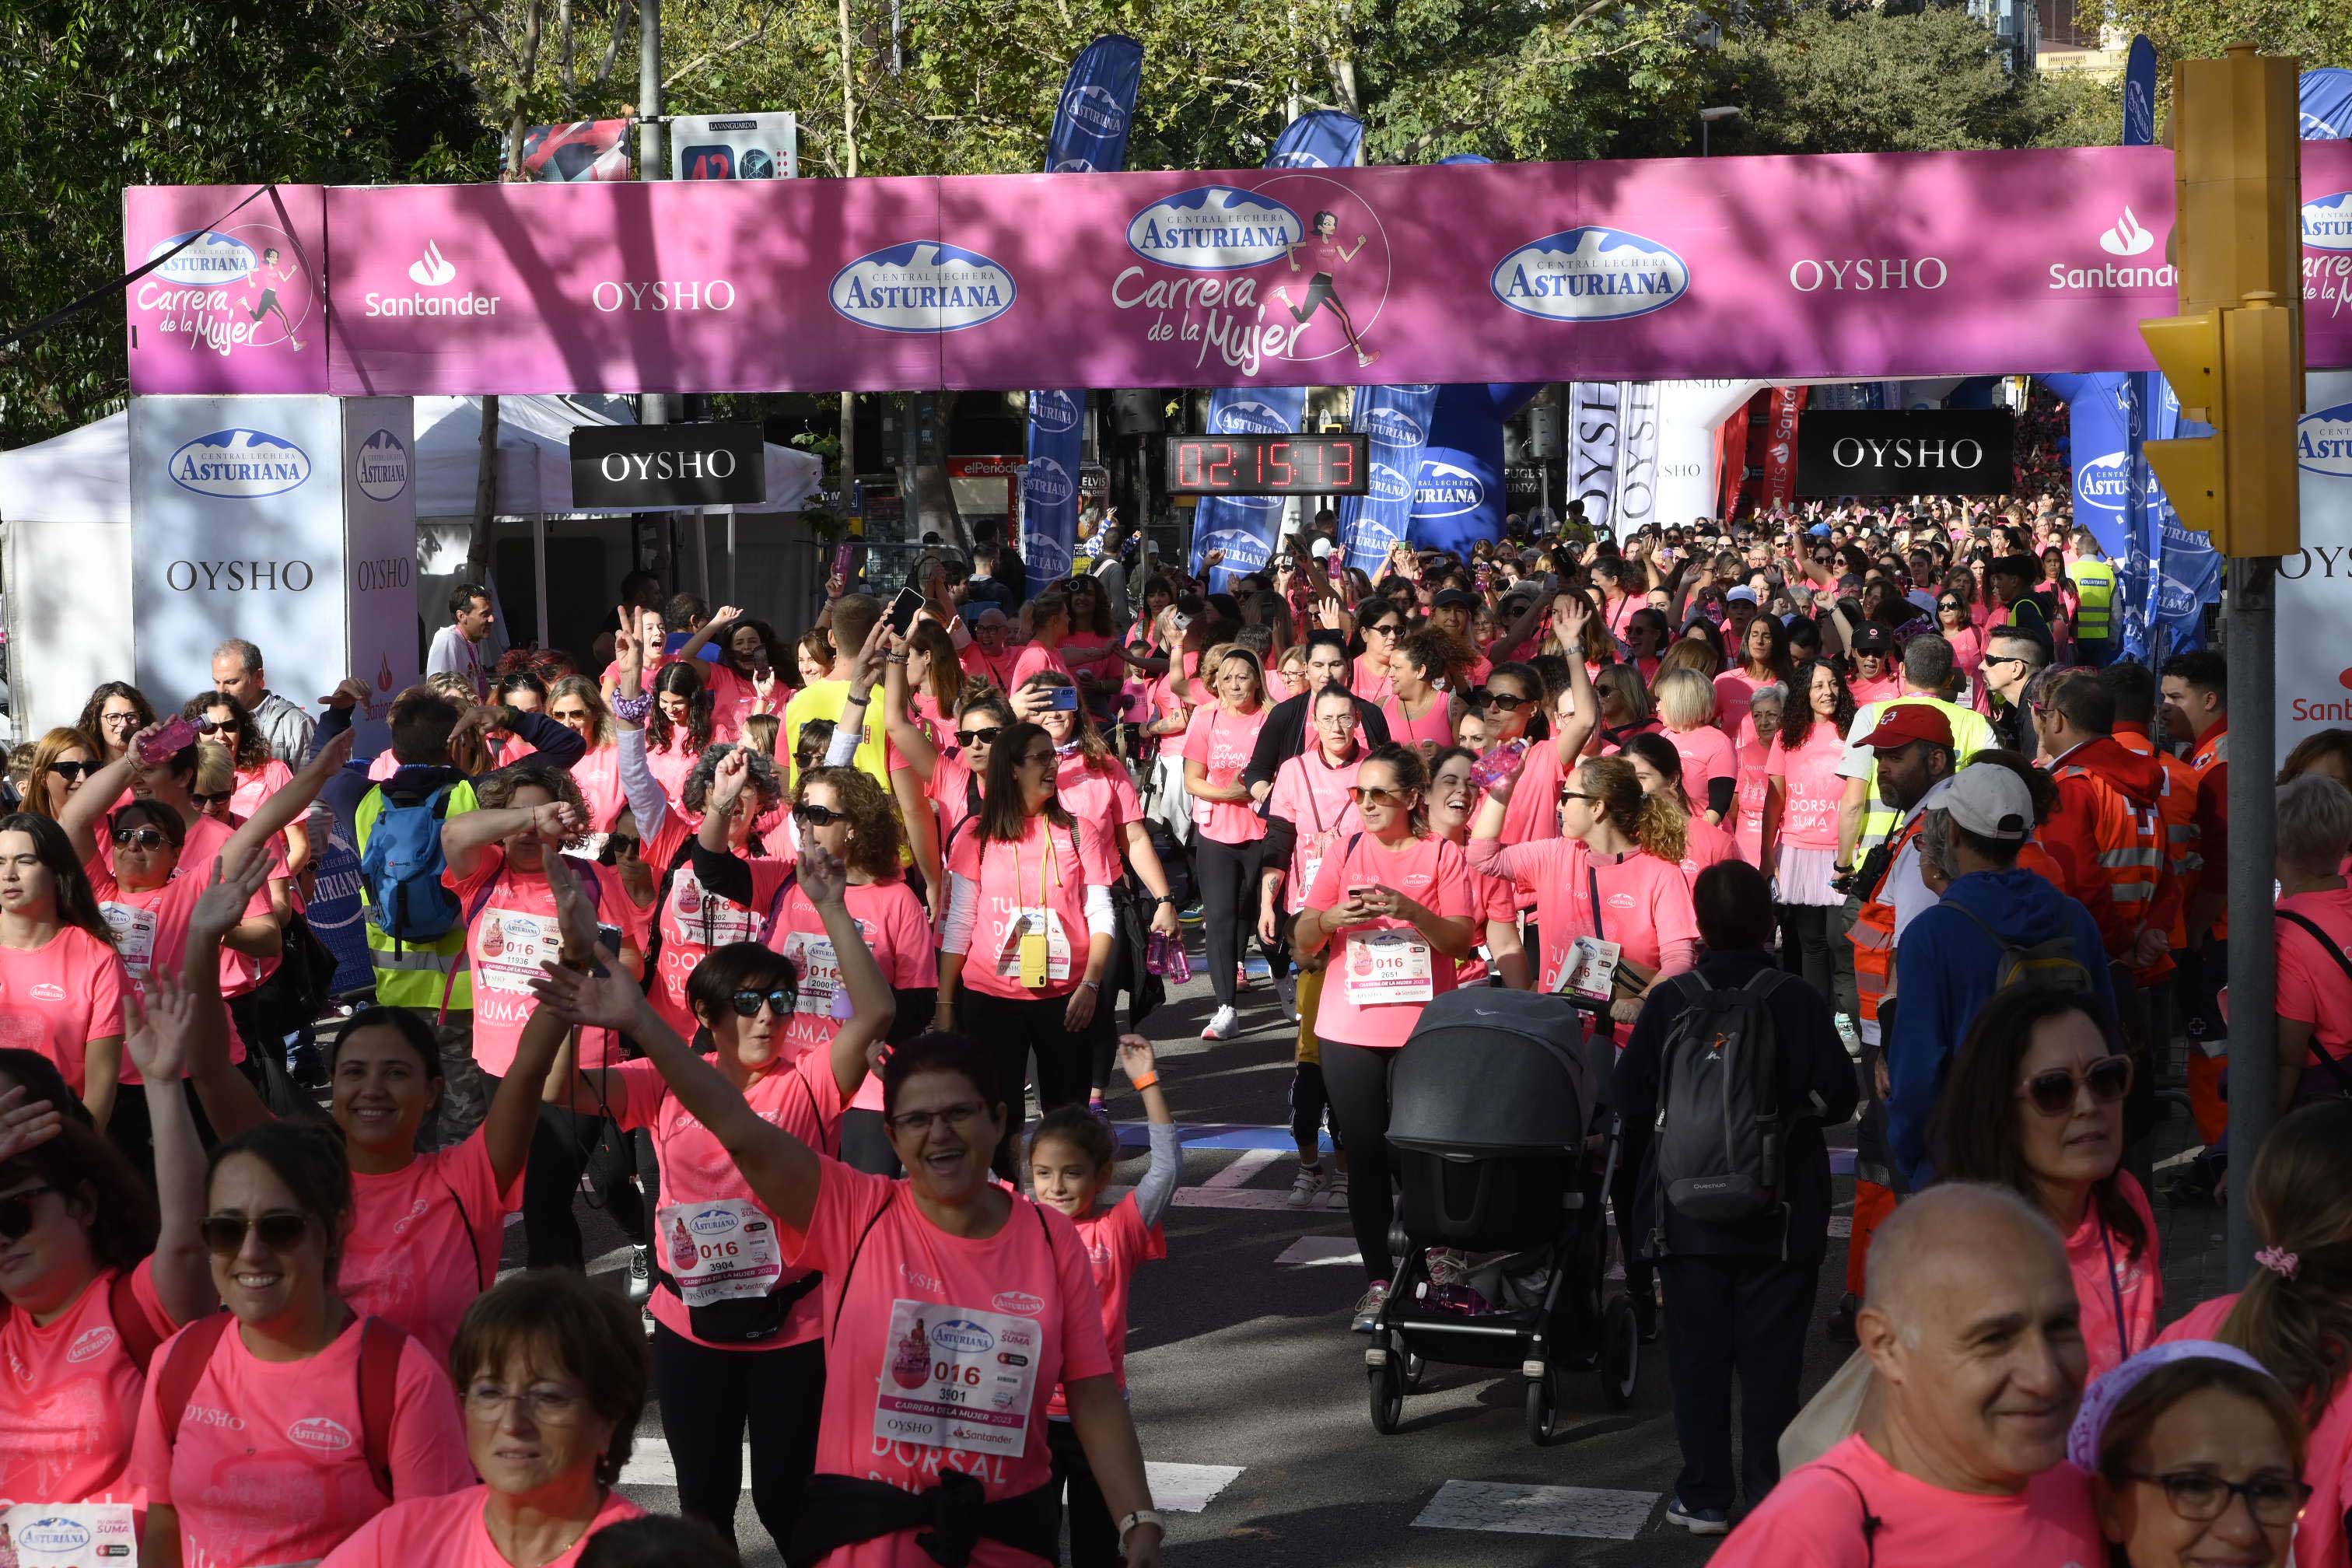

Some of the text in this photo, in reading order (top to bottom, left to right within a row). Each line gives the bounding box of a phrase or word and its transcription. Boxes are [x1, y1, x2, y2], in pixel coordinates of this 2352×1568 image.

[1167, 213, 1284, 224] CENTRAL LECHERA
[1140, 218, 1290, 249] ASTURIANA
[1537, 258, 1667, 270] CENTRAL LECHERA
[1790, 257, 1947, 291] OYSHO
[873, 271, 996, 282] CENTRAL LECHERA
[1111, 266, 1257, 309] Carrera
[1507, 263, 1674, 297] ASTURIANA
[2049, 263, 2179, 289] Santand
[138, 282, 229, 311] Carrera
[593, 280, 735, 311] OYSHO
[844, 275, 1002, 309] ASTURIANA
[2322, 278, 2335, 299] la
[366, 292, 500, 317] Santander
[160, 308, 263, 356] de la Mujer
[1147, 303, 1311, 376] de la Mujer
[1580, 381, 1617, 527] OYSH
[1832, 437, 1983, 468] OYSHO
[180, 454, 300, 480] ASTURIANA
[360, 457, 405, 483] ASTURIANA
[601, 448, 736, 481] OYSHO
[964, 461, 1018, 474] elPeriódi
[1180, 443, 1353, 486] 02:15:13
[1082, 476, 1105, 486] ELVIS
[166, 560, 313, 592] OYSHO
[358, 556, 409, 593] OYSHO
[1213, 744, 1234, 753] HOY
[1210, 761, 1226, 769] LAS
[506, 923, 537, 934] ASTURIANA
[506, 941, 534, 955] 016
[507, 956, 529, 965] 11936
[1376, 957, 1403, 969] 016
[694, 1218, 736, 1231] ASTURIANA
[699, 1241, 739, 1259] 016
[709, 1261, 735, 1272] 3904
[996, 1298, 1041, 1311] ASTURIANA
[71, 1332, 113, 1358] ASTURIANA
[935, 1330, 989, 1349] ASTURIANA
[999, 1334, 1031, 1346] SUMA
[934, 1362, 981, 1385] 016
[939, 1388, 966, 1402] 3901
[895, 1401, 933, 1413] CARRERA
[959, 1410, 989, 1422] MUJER
[992, 1414, 1012, 1425] 2023
[293, 1426, 347, 1446] ASTURIANA
[887, 1418, 1013, 1445] OYSHO Santander
[25, 1529, 84, 1544] ASTURIANA
[96, 1525, 131, 1534] SUMA
